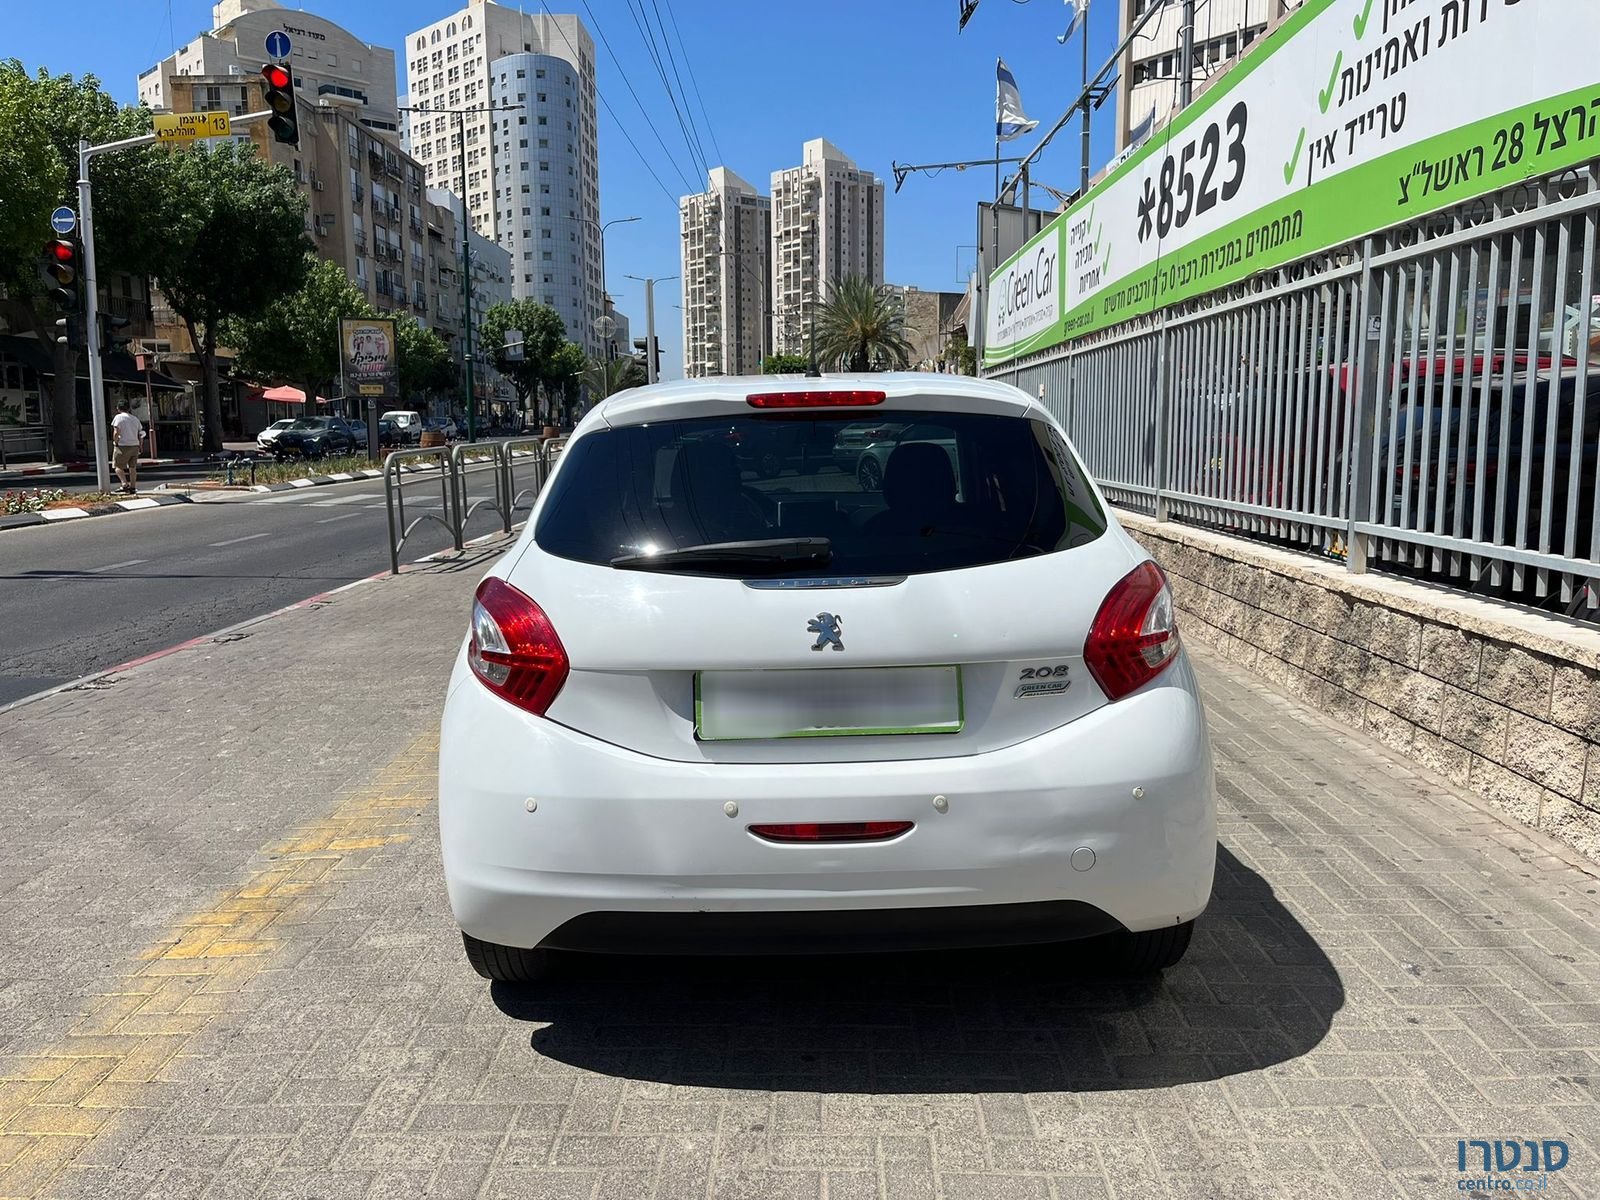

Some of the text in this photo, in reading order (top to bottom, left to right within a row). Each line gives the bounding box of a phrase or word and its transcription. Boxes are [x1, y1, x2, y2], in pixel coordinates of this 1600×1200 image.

[1338, 16, 1430, 108] ואמינות
[179, 115, 200, 126] ויצמן
[212, 118, 226, 130] 13
[1307, 91, 1407, 187] טרייד אין
[1397, 98, 1600, 205] הרצל 28 ראשל"צ
[1070, 219, 1086, 246] קנייה
[1245, 209, 1303, 259] מתמחים
[1075, 242, 1093, 269] מכירה
[1200, 238, 1242, 278] במכירת
[1007, 247, 1056, 317] Green Car
[1079, 266, 1100, 295] אחריות
[1178, 258, 1197, 287] רכבי
[1104, 290, 1126, 316] חדשים
[1127, 279, 1151, 306] ורכבים
[1019, 665, 1070, 681] 208
